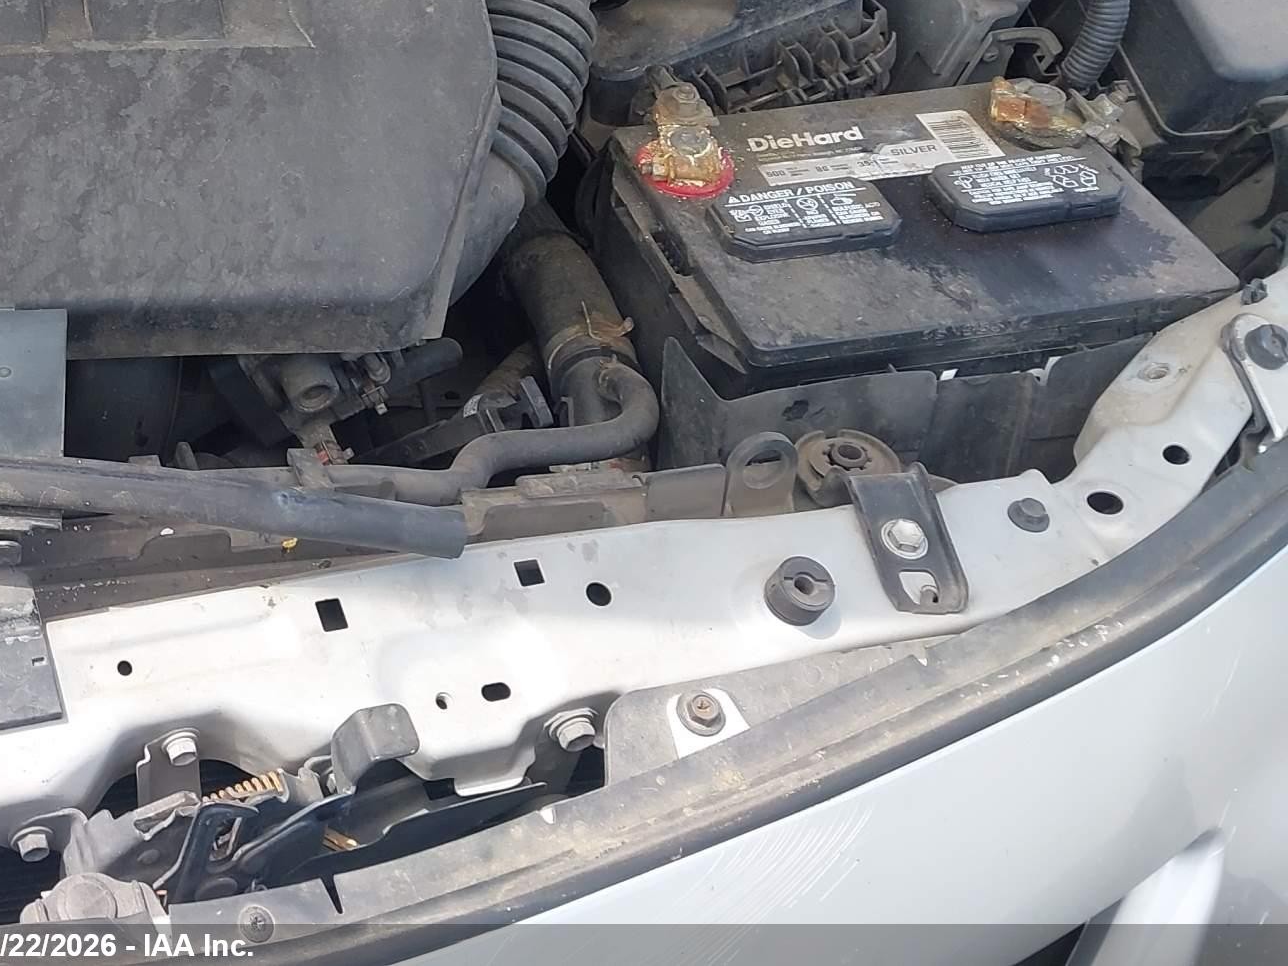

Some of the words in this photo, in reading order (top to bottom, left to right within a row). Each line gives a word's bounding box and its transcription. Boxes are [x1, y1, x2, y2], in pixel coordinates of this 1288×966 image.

[748, 126, 863, 152] DieHard
[890, 143, 938, 156] SILVER
[739, 189, 794, 204] DANGER
[805, 181, 855, 194] POISON
